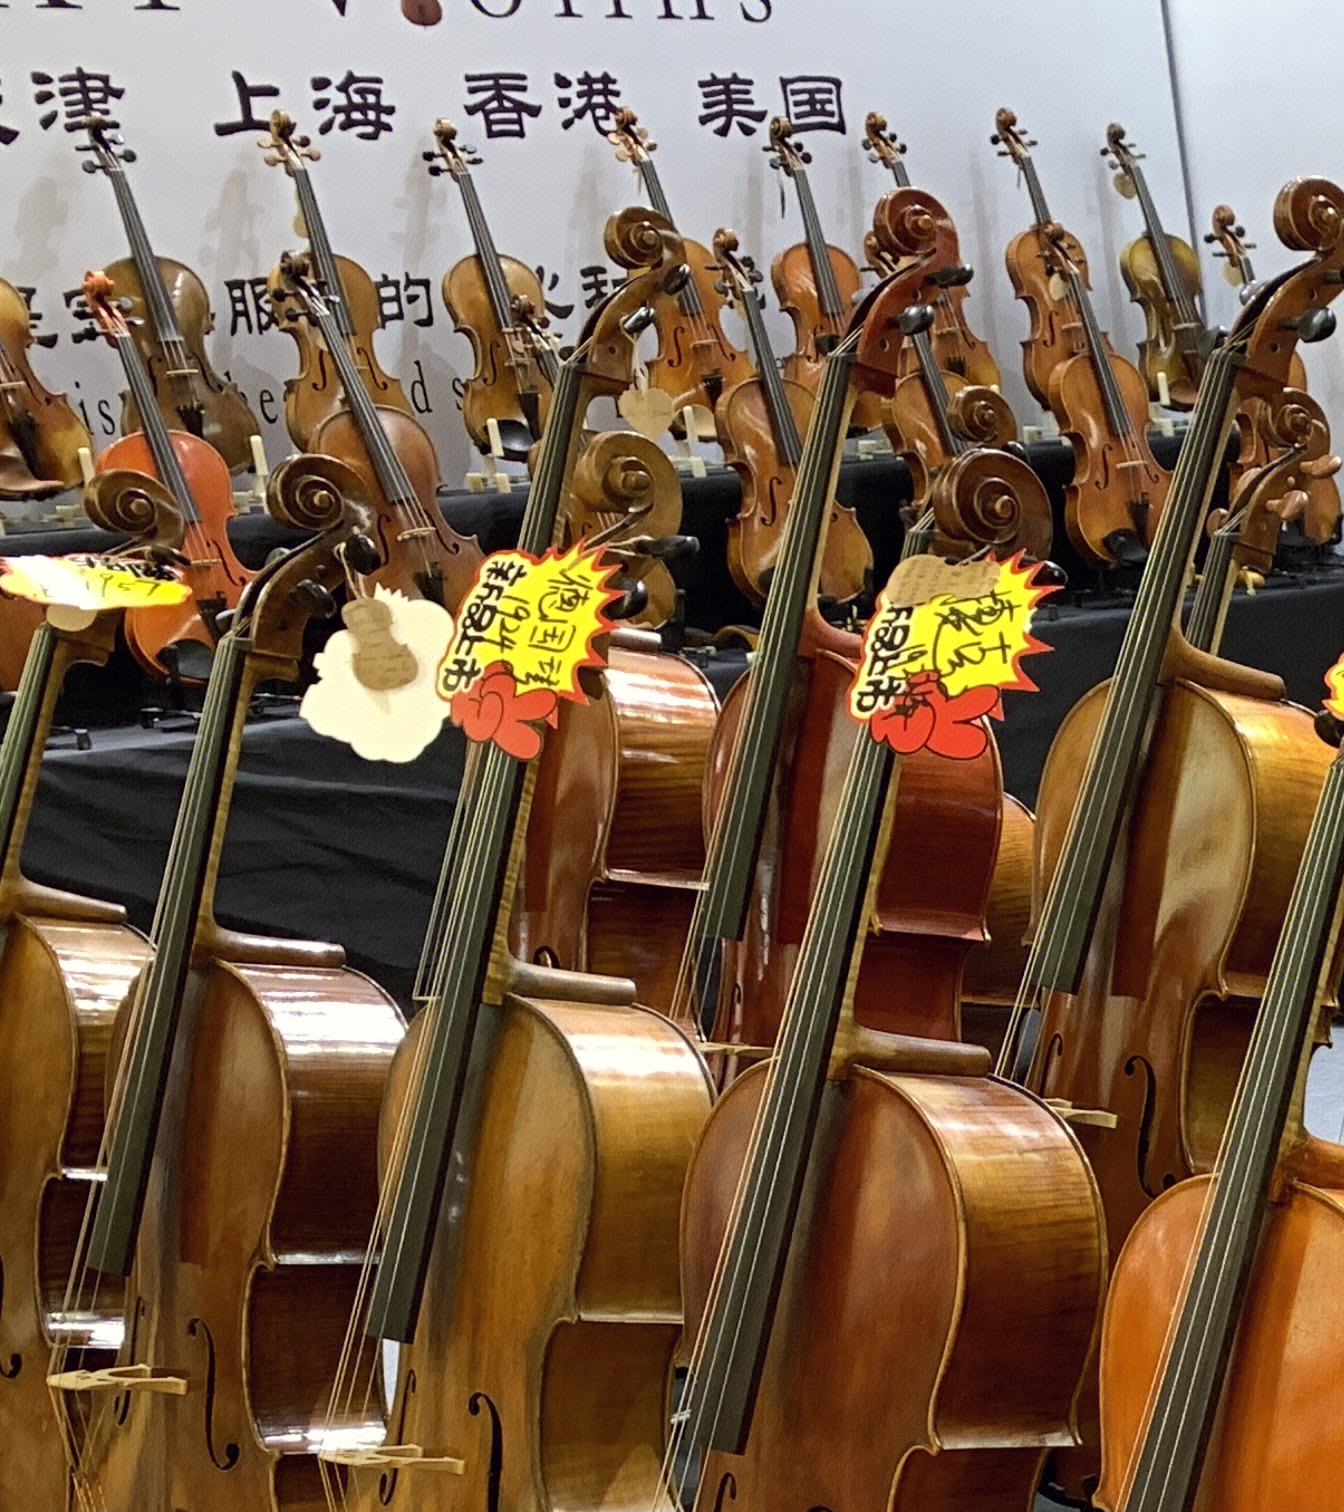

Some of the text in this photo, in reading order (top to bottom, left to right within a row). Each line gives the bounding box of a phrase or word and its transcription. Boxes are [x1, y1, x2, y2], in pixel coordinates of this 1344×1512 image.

[0, 66, 847, 146] 津 上海 香港 美国
[76, 381, 116, 435] is
[442, 561, 527, 692] 新品上市
